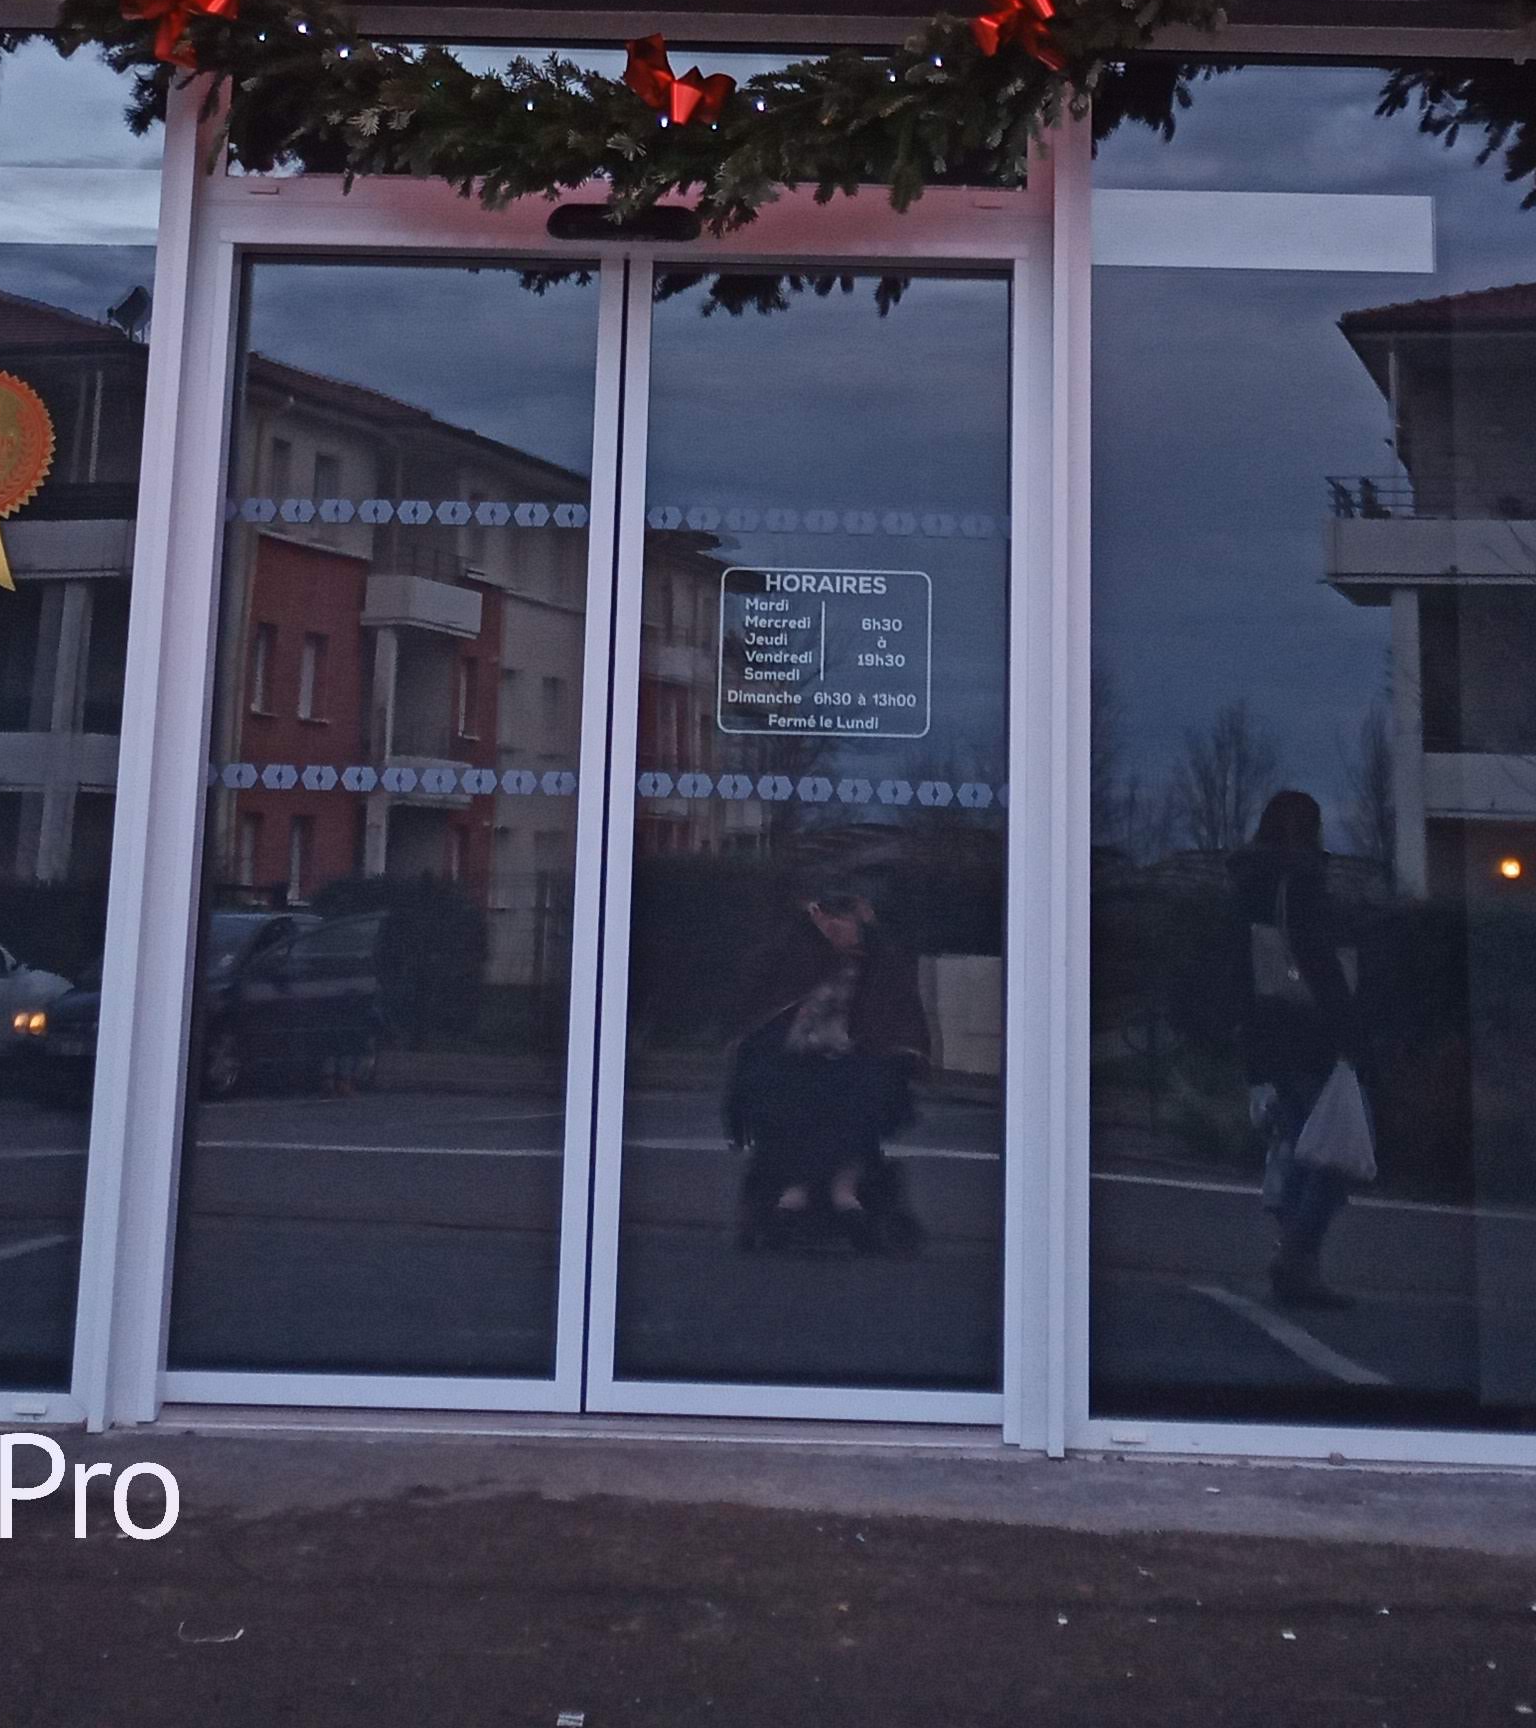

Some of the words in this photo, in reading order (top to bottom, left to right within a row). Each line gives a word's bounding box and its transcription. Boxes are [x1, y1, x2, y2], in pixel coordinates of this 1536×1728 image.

[765, 573, 888, 595] HORAIRES
[745, 598, 790, 612] Mardi
[744, 615, 812, 630] Mercredi
[861, 618, 904, 633] 6h30
[744, 632, 789, 647] Jeudi
[876, 635, 888, 649] à
[745, 650, 814, 665] Vendredi
[856, 653, 906, 668] 19h30
[743, 667, 801, 682] Samedi
[727, 689, 803, 705] Dimanche
[813, 691, 852, 706] 6h30
[857, 692, 867, 706] à
[872, 692, 917, 708] 13h00
[767, 713, 817, 729] Fermé
[819, 715, 834, 729] le
[836, 715, 880, 730] Lundi
